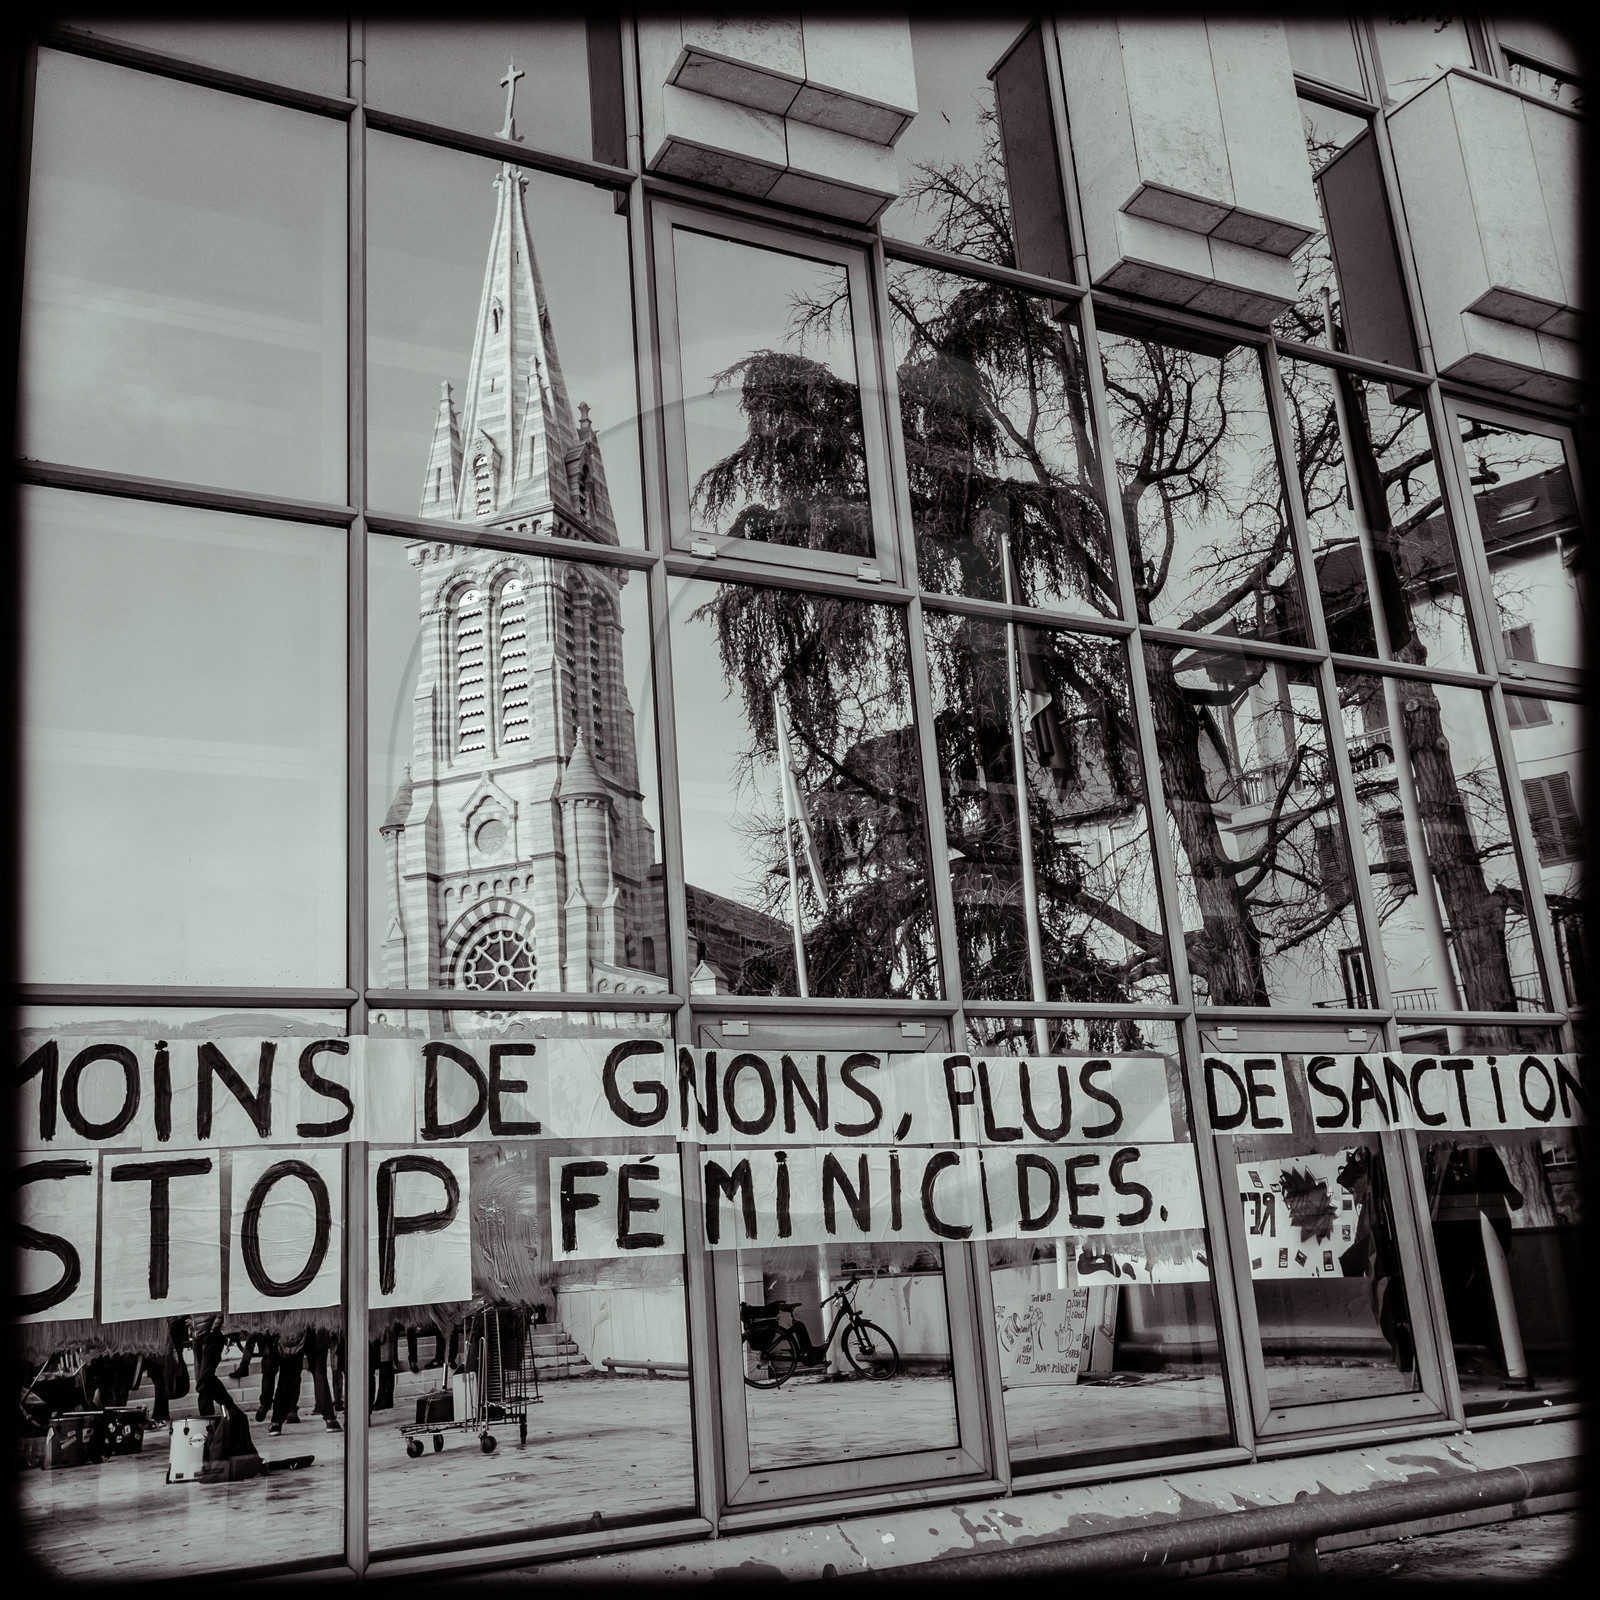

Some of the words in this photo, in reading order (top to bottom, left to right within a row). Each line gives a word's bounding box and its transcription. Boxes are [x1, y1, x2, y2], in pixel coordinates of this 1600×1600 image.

[421, 1041, 541, 1141] DE
[602, 1039, 912, 1142] GNONS,
[943, 1054, 1124, 1143] PLUS
[1204, 1056, 1284, 1130] DE
[12, 1153, 461, 1316] STOP
